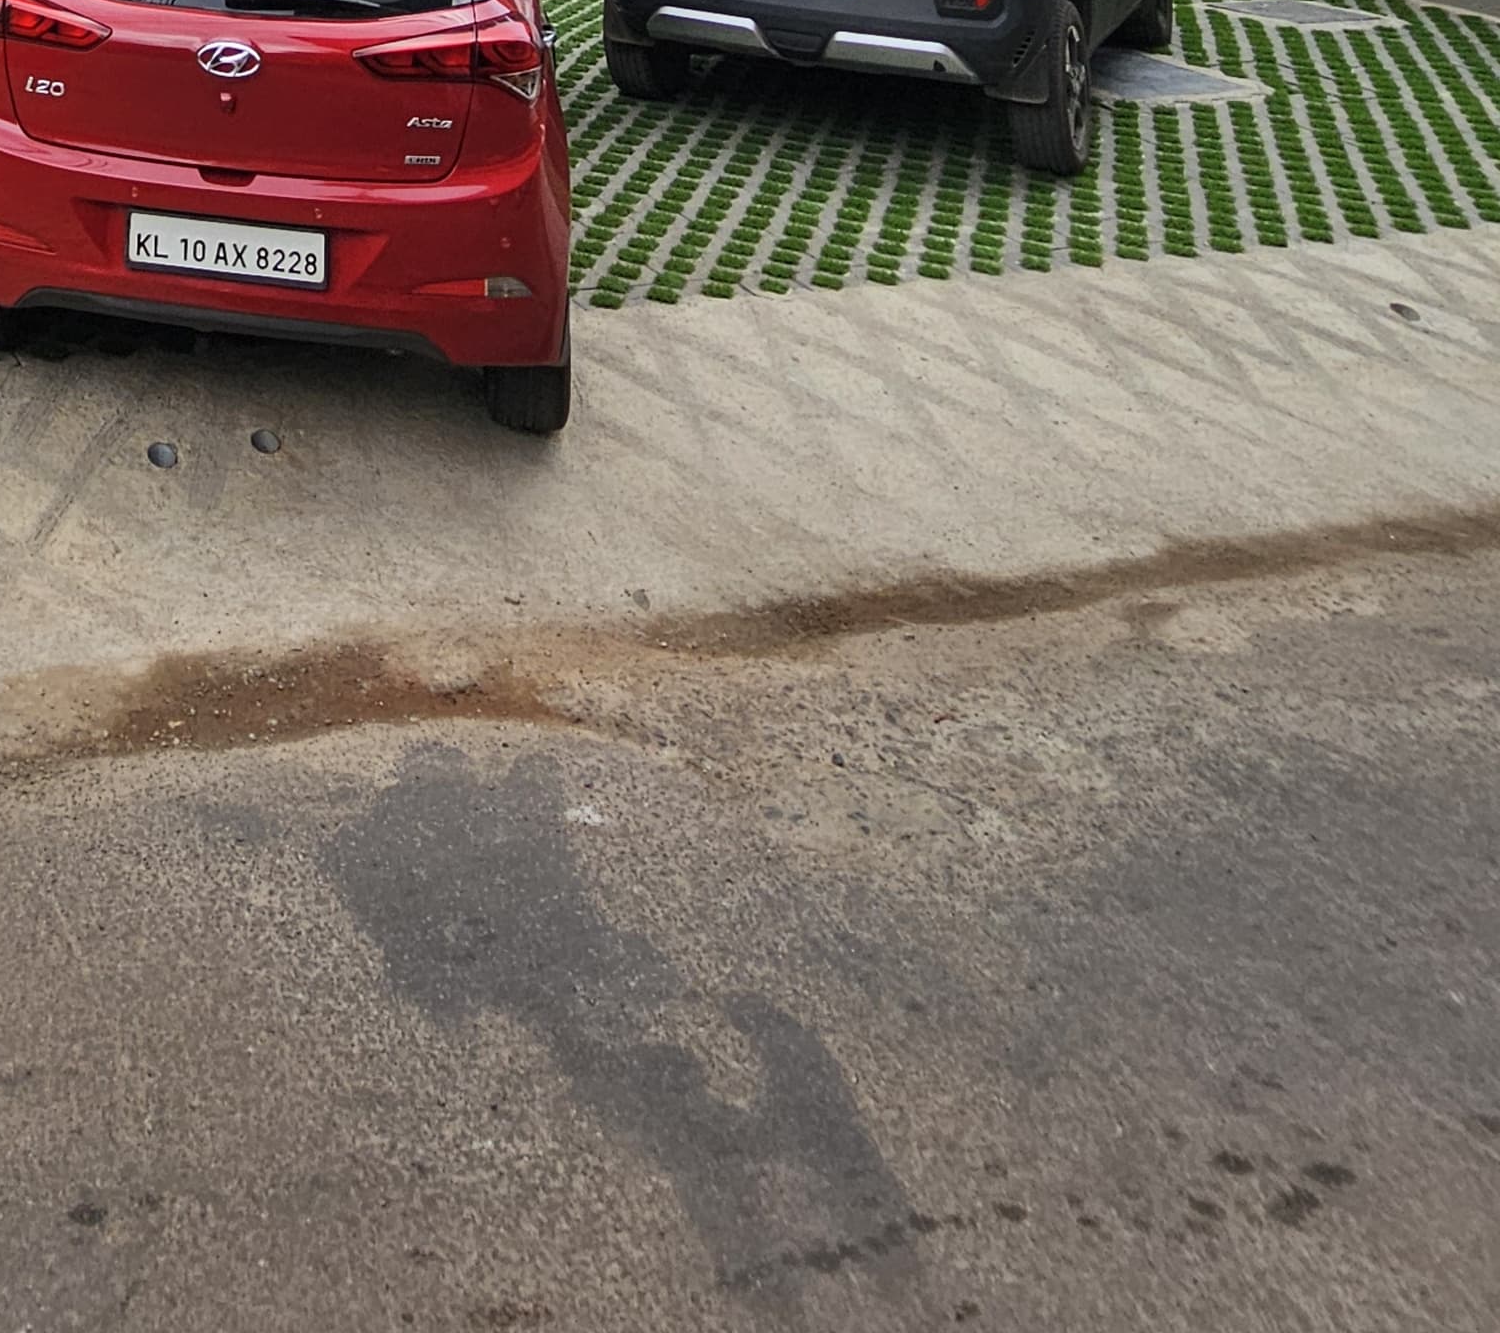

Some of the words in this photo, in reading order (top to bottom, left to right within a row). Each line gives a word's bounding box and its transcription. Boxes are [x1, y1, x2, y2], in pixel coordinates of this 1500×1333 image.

[406, 116, 453, 129] Asta
[136, 233, 169, 259] KL
[179, 237, 206, 263] 10
[214, 242, 248, 268] AX
[256, 247, 318, 276] 8228
